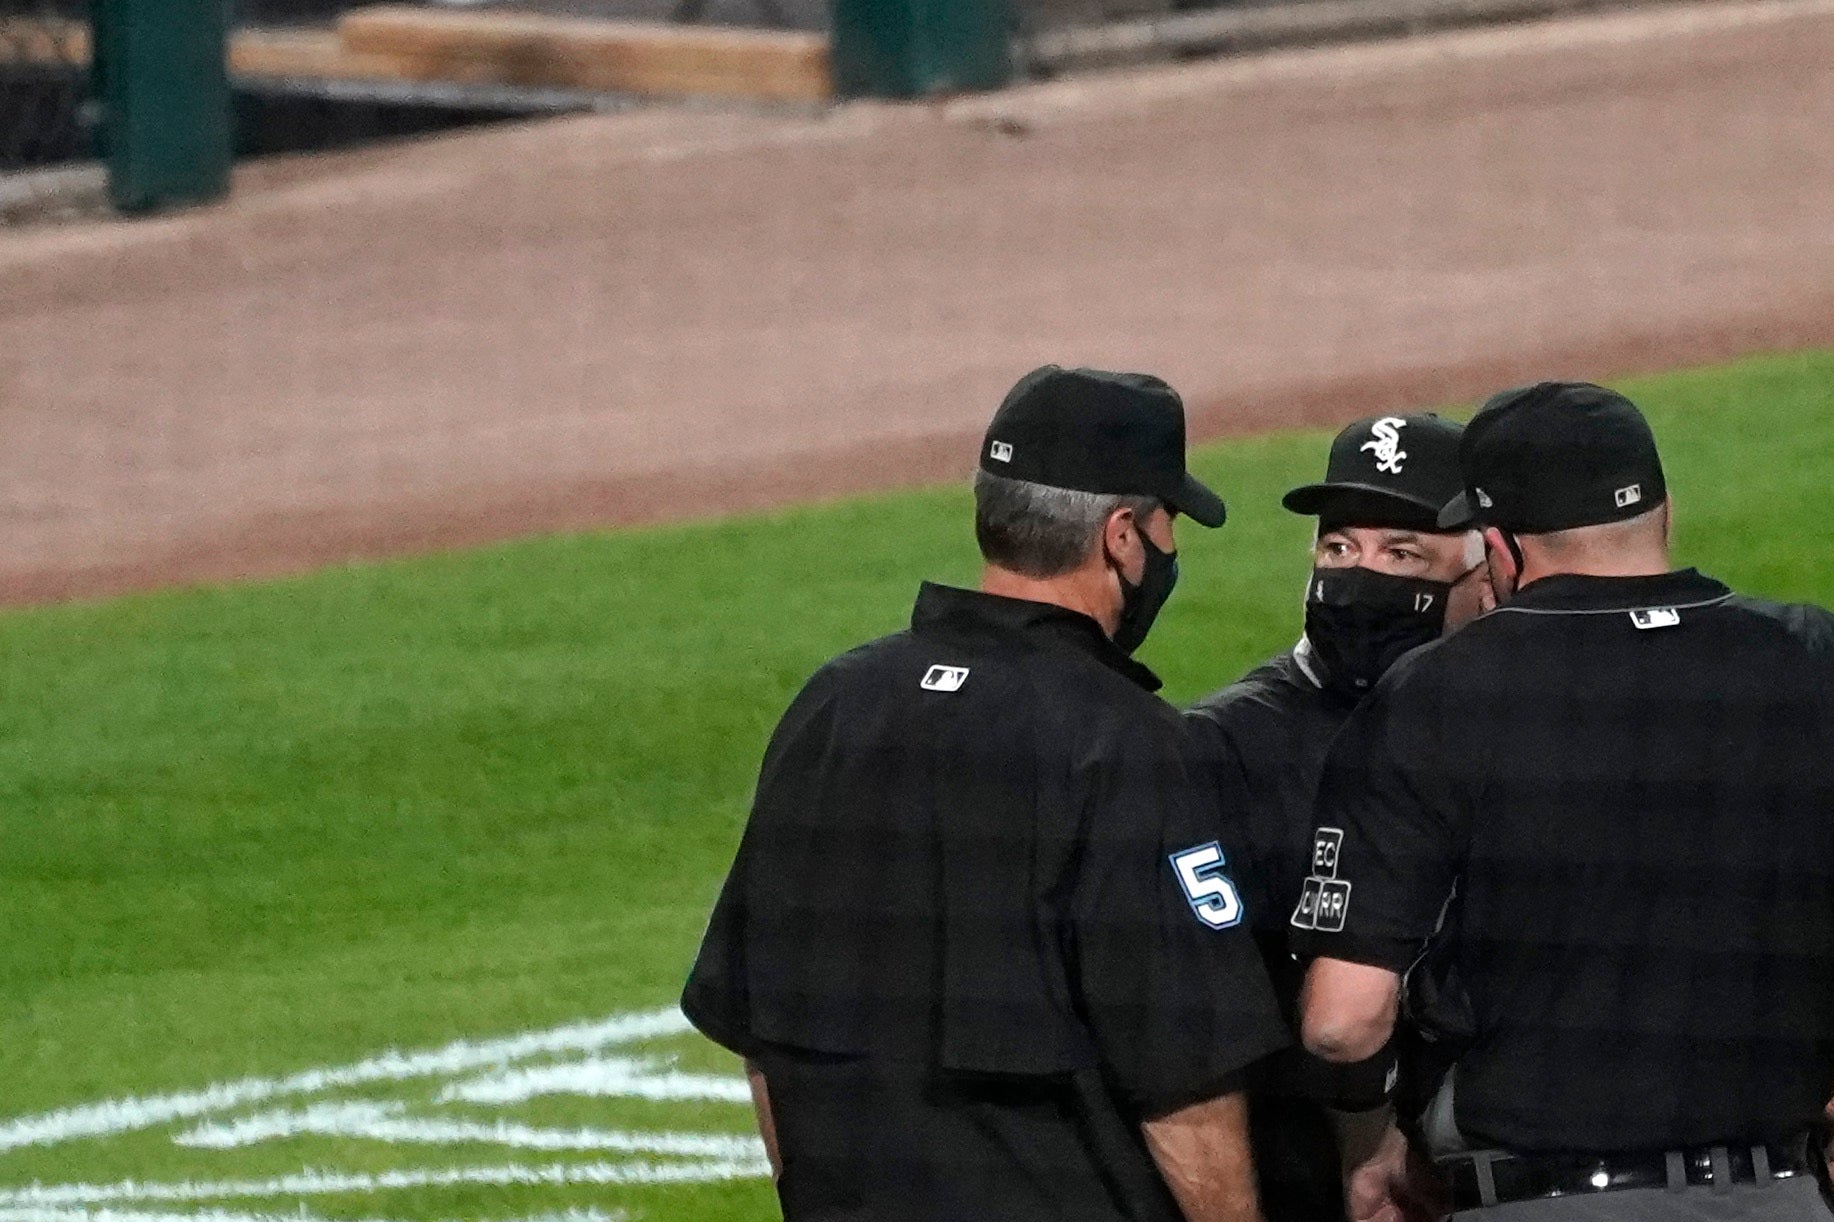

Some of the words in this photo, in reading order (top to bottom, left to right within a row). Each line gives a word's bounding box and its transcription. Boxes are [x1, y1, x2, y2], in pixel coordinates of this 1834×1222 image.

[1413, 593, 1434, 613] 17
[1168, 841, 1244, 931] 5
[1319, 891, 1344, 918] RR
